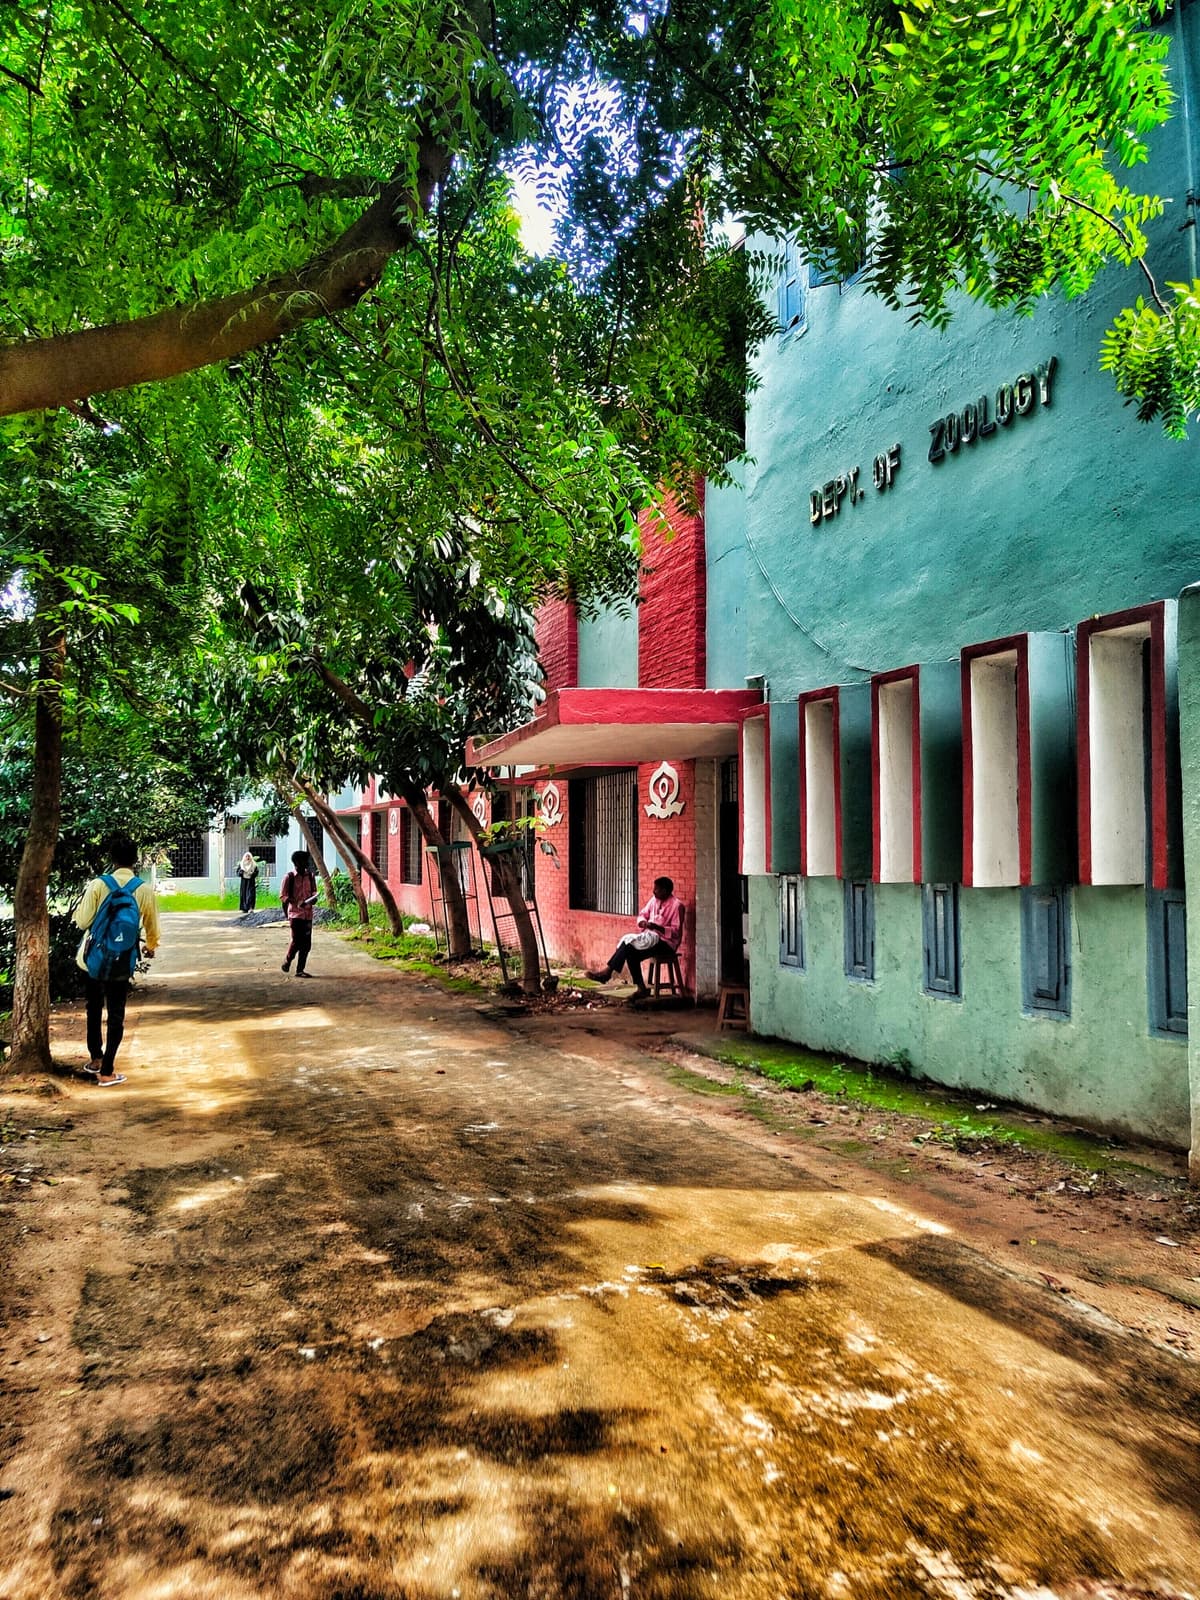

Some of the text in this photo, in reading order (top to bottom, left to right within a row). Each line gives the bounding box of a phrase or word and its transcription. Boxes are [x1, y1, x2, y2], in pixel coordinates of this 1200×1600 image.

[809, 355, 1058, 525] DEPT. OF ZOOLOGY
